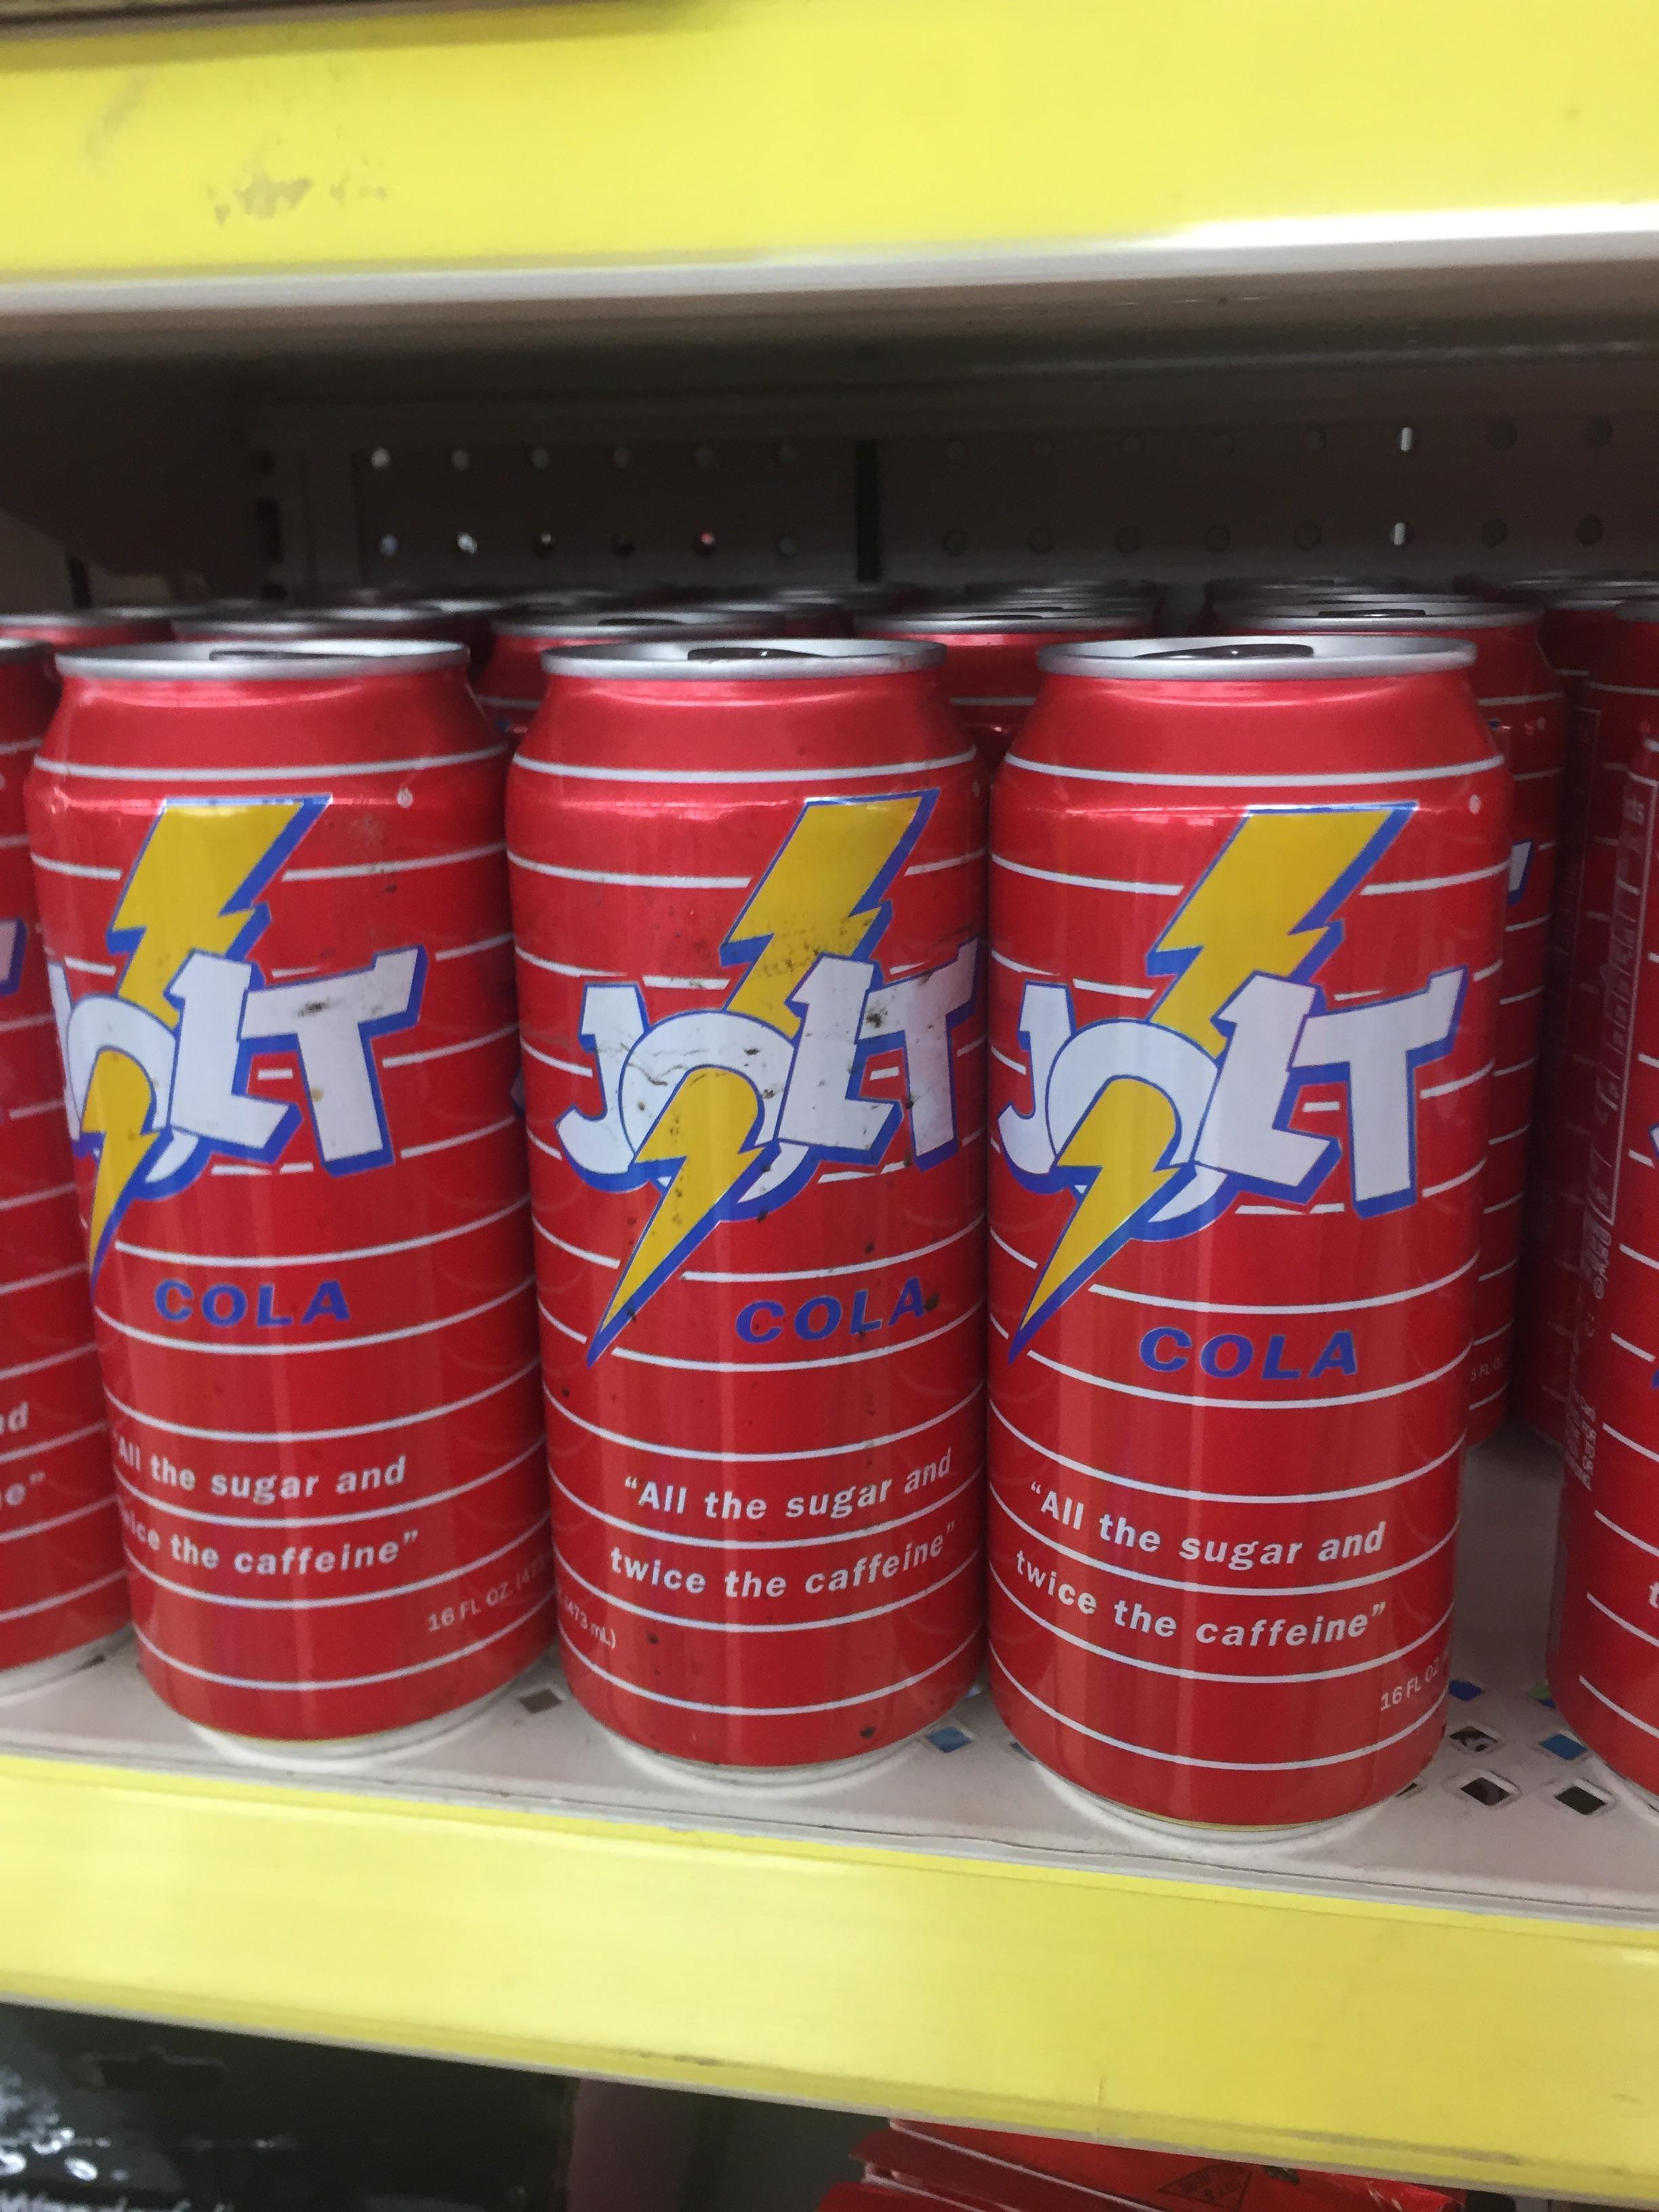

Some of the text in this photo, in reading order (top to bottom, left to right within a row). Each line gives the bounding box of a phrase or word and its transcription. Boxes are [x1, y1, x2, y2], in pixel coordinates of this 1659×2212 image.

[554, 935, 980, 1224] JOLT
[998, 965, 1468, 1242] JOLT
[154, 1279, 351, 1328] COLA
[735, 1275, 925, 1345] COLA
[1139, 1326, 1358, 1380] COLA
[150, 1453, 196, 1491] the
[210, 1472, 320, 1505] sugar
[336, 1454, 407, 1492] and
[624, 1446, 952, 1520] “All the sugar and
[170, 1534, 220, 1570] the
[233, 1530, 419, 1576] caffeine”
[610, 1522, 955, 1599] twice the caffeine”
[1030, 1481, 1387, 1570] “All the sugar and
[428, 1607, 455, 1633] 16
[459, 1598, 482, 1620] FL
[1015, 1549, 1387, 1647] twice the caffeine”
[1380, 1691, 1403, 1712] 16
